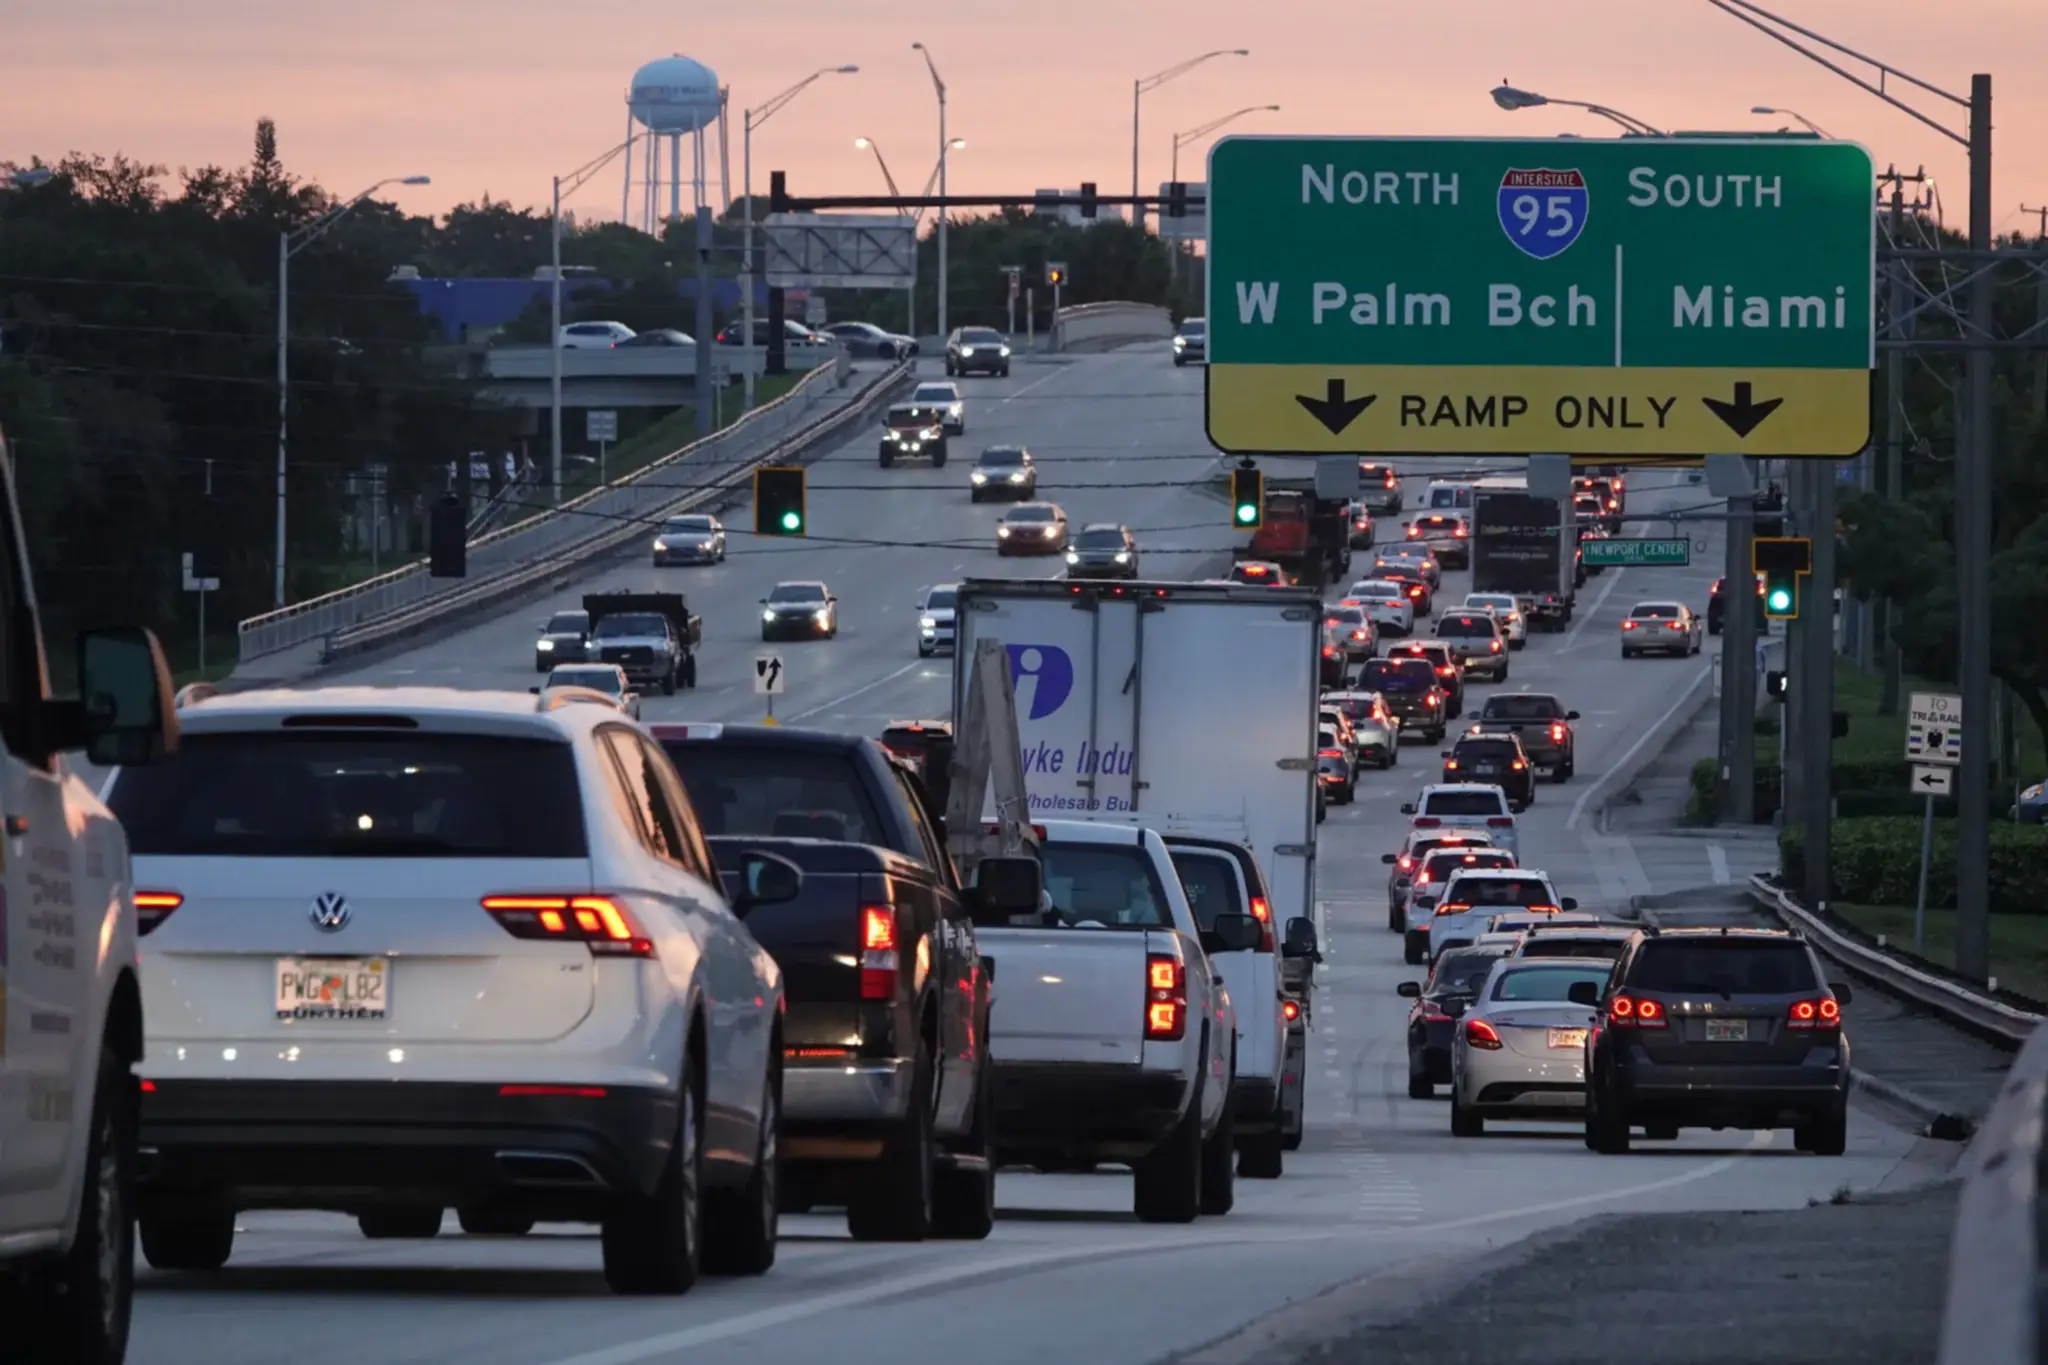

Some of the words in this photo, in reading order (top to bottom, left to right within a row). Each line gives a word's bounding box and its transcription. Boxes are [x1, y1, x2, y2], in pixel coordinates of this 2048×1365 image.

[1301, 163, 1460, 206] NORTH
[1509, 170, 1576, 188] INTERSTATE
[1627, 166, 1782, 209] SOUTH
[1511, 194, 1575, 238] 95
[1235, 280, 1280, 325] W
[1312, 280, 1451, 326] Palm
[1488, 282, 1598, 328] Bch
[1672, 284, 1846, 329] Miami
[1400, 395, 1528, 428] RAMP
[1555, 395, 1677, 430] ONLY
[1590, 543, 1641, 557] NEWPORT
[1644, 542, 1685, 556] CENTER
[1912, 711, 1927, 722] TRI
[1930, 697, 1948, 712] TO
[1022, 740, 1065, 777] yke
